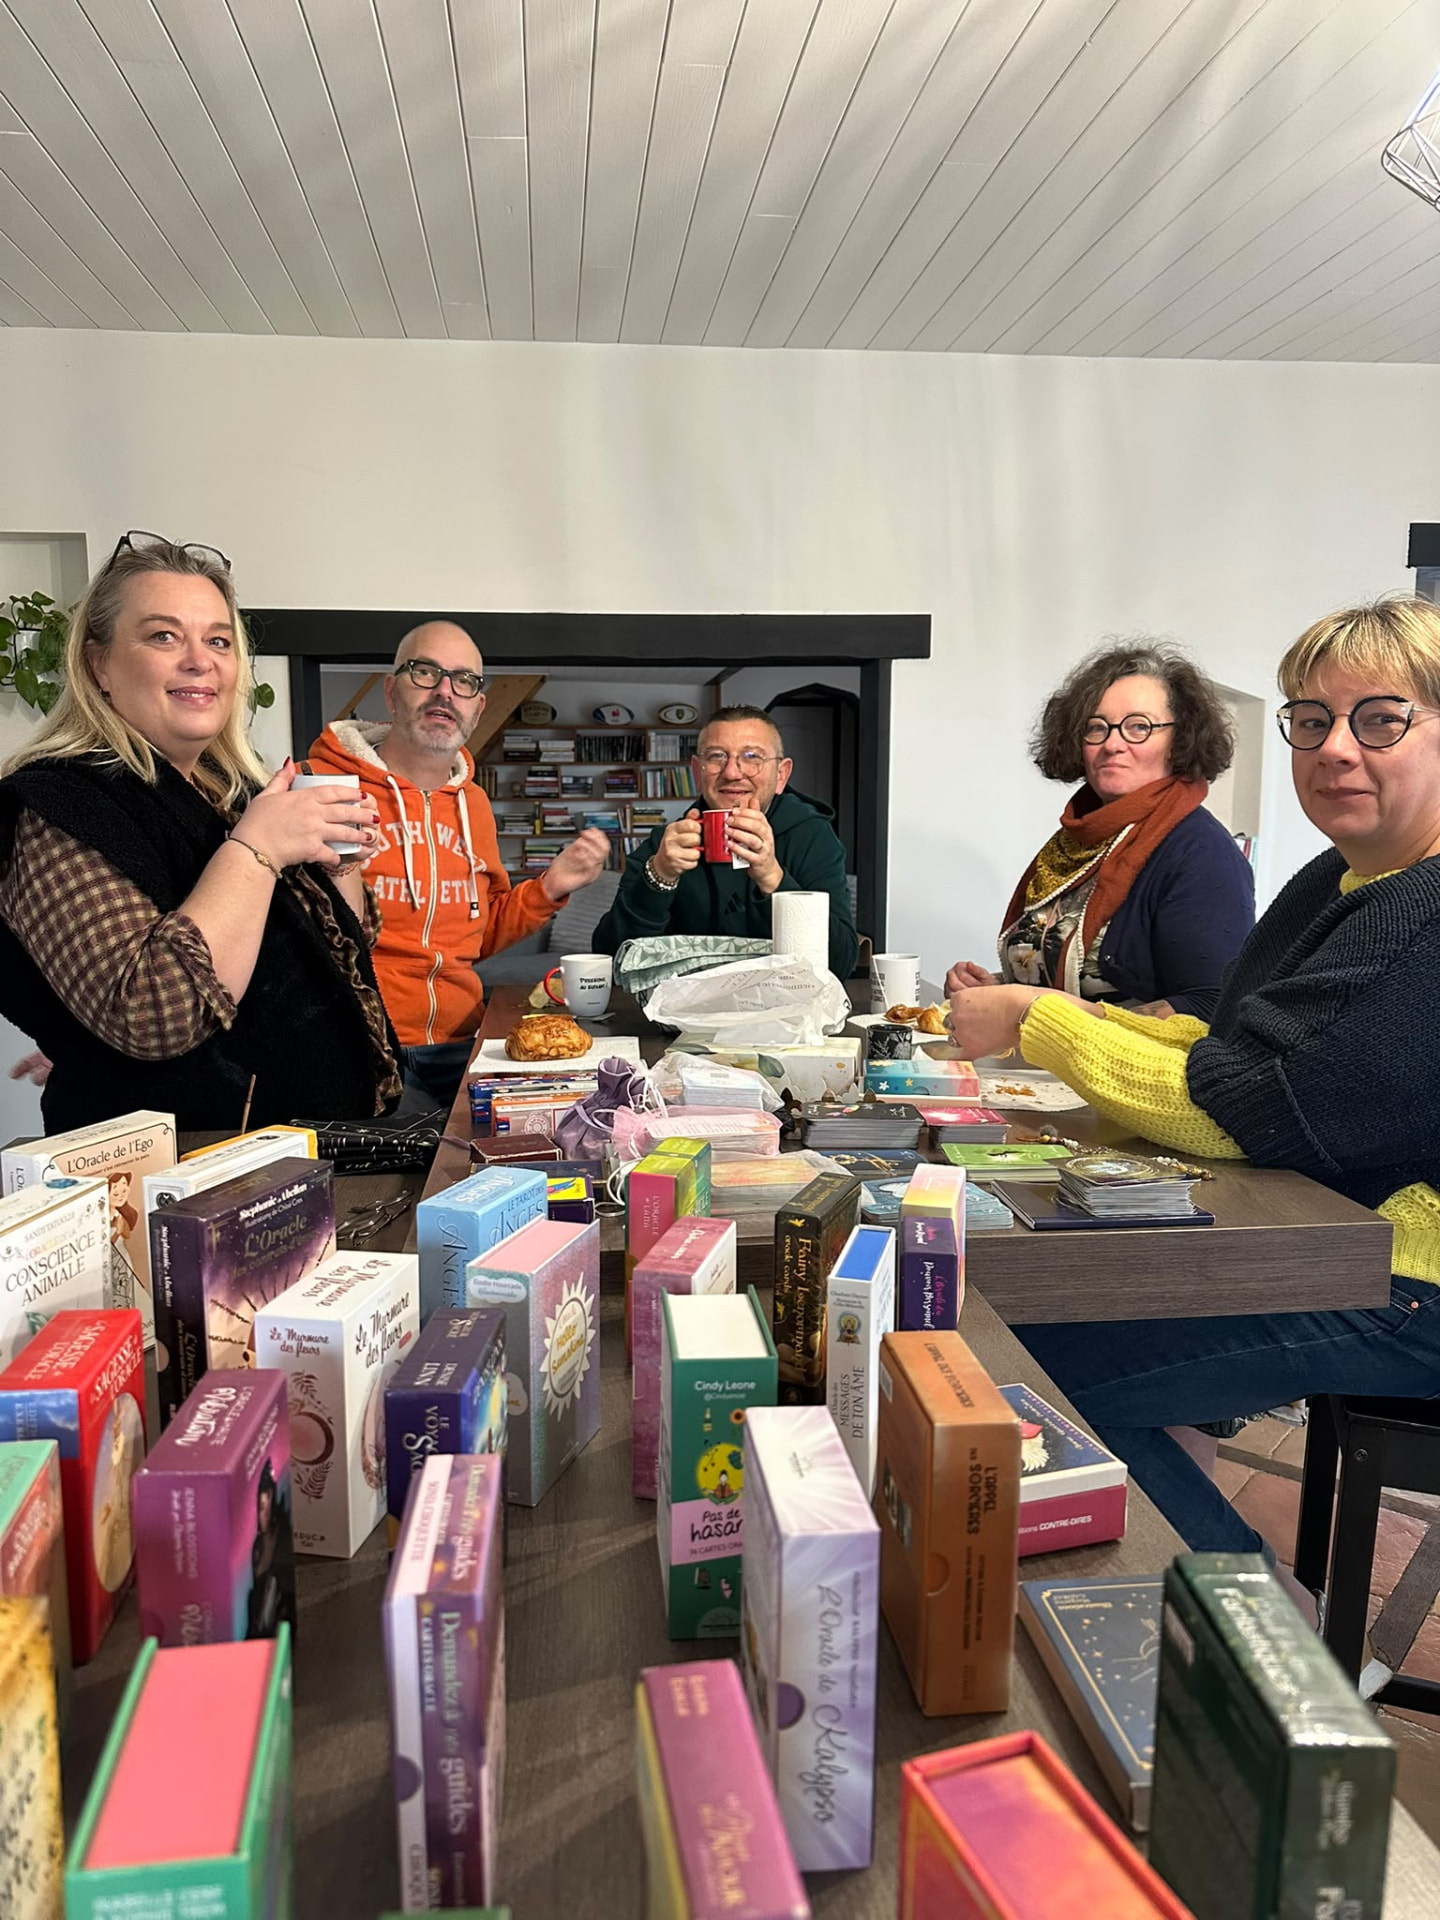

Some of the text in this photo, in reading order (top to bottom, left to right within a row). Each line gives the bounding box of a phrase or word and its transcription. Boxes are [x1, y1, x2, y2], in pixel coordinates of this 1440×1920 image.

[360, 821, 425, 870] UTH
[67, 1153, 110, 1173] L'Oracle
[114, 1144, 127, 1158] de
[129, 1138, 153, 1155] l'Ego
[507, 1199, 515, 1212] LE
[515, 1188, 536, 1207] TAROT
[244, 1215, 307, 1259] L'Oracle
[489, 1199, 545, 1247] ANGES
[5, 1231, 95, 1292] CONSCIENCE
[22, 1255, 85, 1306] ANIMALE
[355, 1292, 410, 1355] Le Murmure
[791, 1237, 812, 1371] Fairy Lenormand
[55, 1325, 106, 1369] SAGESSE
[269, 1327, 331, 1344] Le Murmure
[280, 1341, 321, 1358] des fleurs
[366, 1321, 402, 1368] des fleurs
[414, 1362, 440, 1387] LINN
[694, 1380, 756, 1392] Cindy Leone
[839, 1373, 850, 1427] MESSAGES
[849, 1365, 865, 1439] DE TON ÂME
[439, 1416, 449, 1430] LE
[984, 1466, 997, 1513] L'APPEL
[691, 1519, 743, 1542] hasar
[702, 1508, 741, 1522] Pas de
[1039, 1515, 1092, 1531] CONTRE-DIRES
[699, 1544, 726, 1554] CARTES
[818, 1673, 838, 1693] de
[799, 1704, 849, 1823] Kalypso
[437, 1757, 474, 1835] guides
